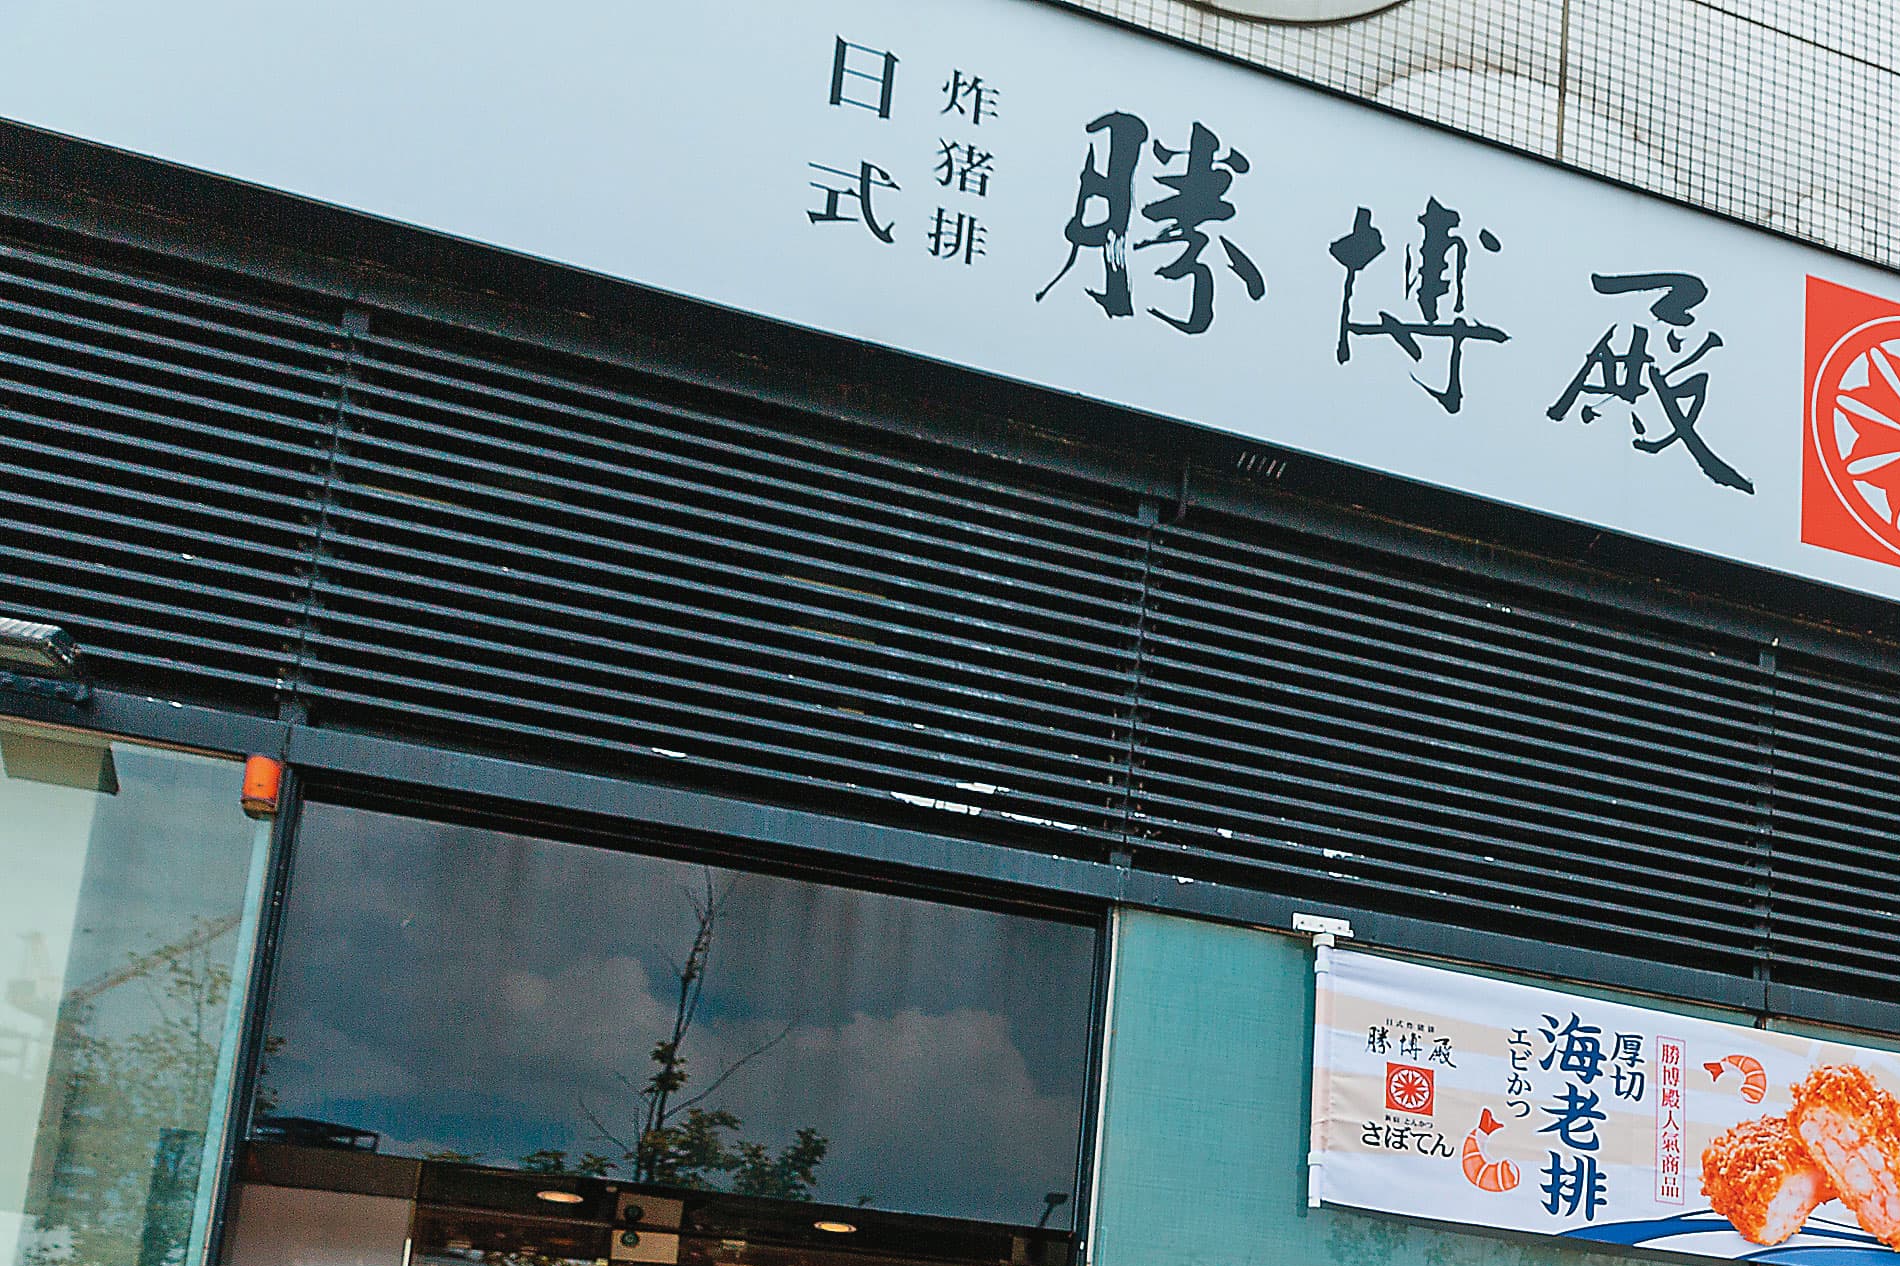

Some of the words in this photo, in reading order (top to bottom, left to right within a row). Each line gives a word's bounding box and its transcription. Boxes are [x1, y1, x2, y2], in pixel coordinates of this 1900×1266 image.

[808, 35, 900, 246] 日式
[1037, 110, 1754, 494] 勝博殿
[1365, 1026, 1456, 1068] 勝博殿
[1507, 1028, 1531, 1117] エビかつ
[1609, 1033, 1645, 1101] 厚切
[1362, 1121, 1454, 1157] さぼてん
[1537, 1012, 1607, 1221] 海老排
[1661, 1044, 1680, 1198] 勝博殿人氣商品
